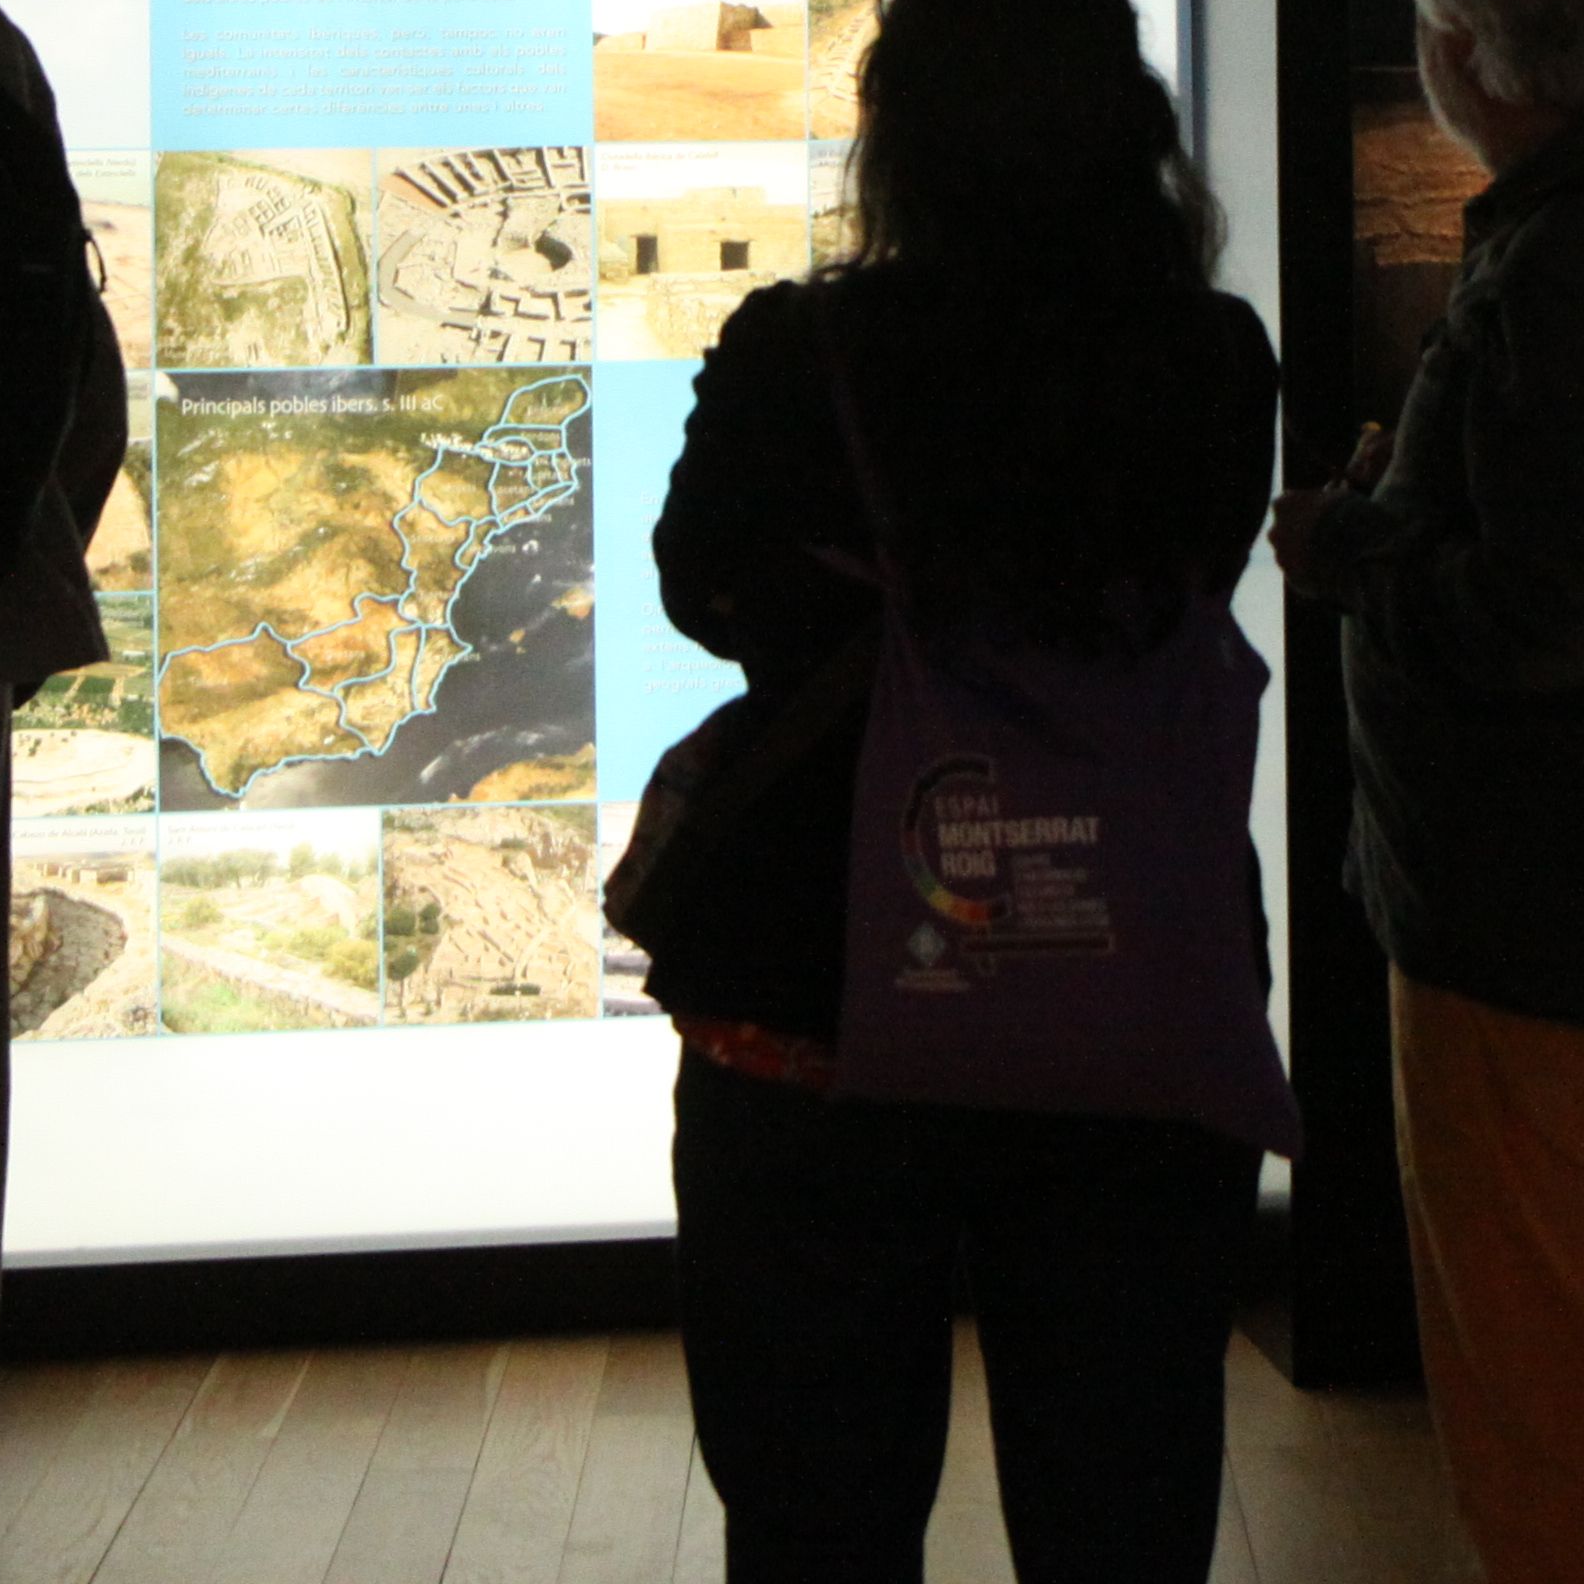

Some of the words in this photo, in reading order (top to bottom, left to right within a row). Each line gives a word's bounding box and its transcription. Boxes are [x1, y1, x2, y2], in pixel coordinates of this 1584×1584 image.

[182, 396, 265, 419] Principals
[270, 394, 327, 417] pobles
[331, 394, 378, 415] ibers.
[382, 398, 395, 412] s.
[400, 394, 416, 412] III
[420, 393, 445, 411] aC
[934, 794, 1000, 817] ESPAI
[938, 816, 1100, 848] MONTSERRAT
[941, 850, 997, 878] ROIG
